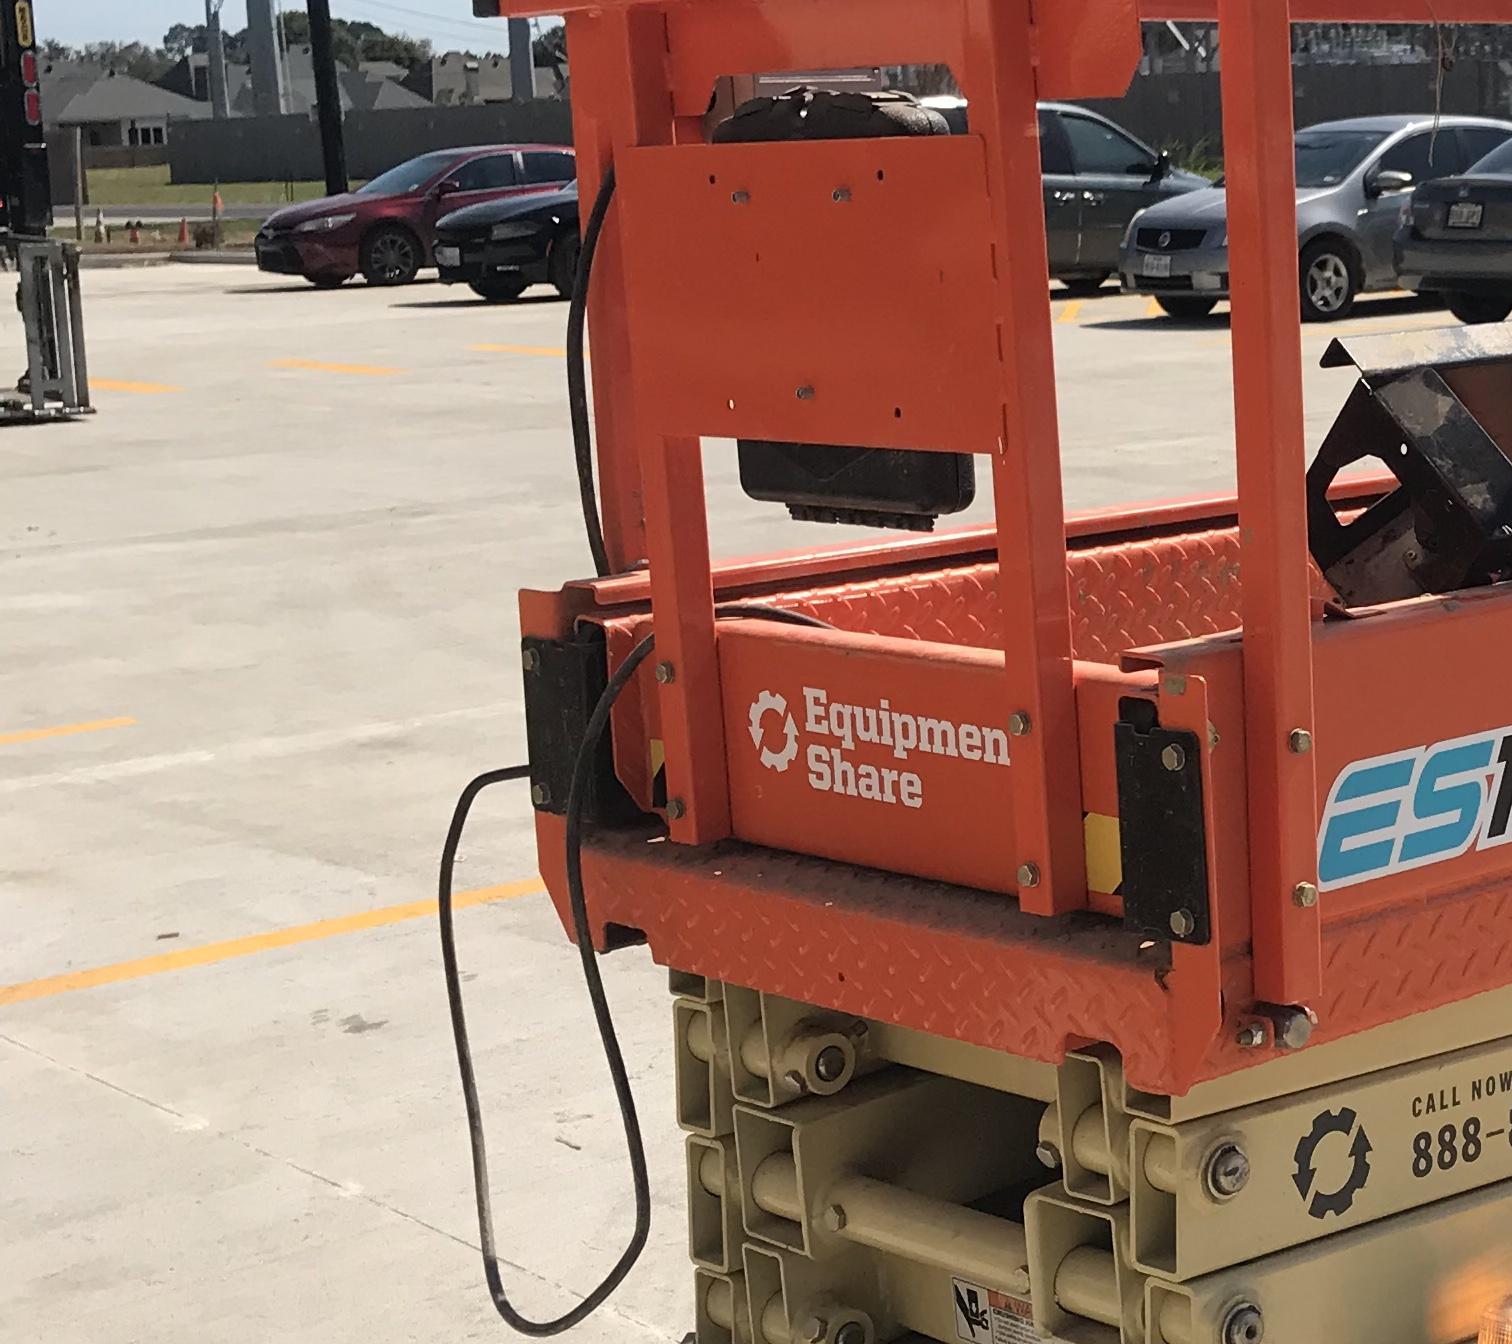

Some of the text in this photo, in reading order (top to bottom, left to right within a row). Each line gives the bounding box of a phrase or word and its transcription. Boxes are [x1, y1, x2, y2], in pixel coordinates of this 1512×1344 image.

[802, 686, 1011, 767] Equipmen
[807, 745, 923, 809] Share
[1411, 1086, 1461, 1118] CALL
